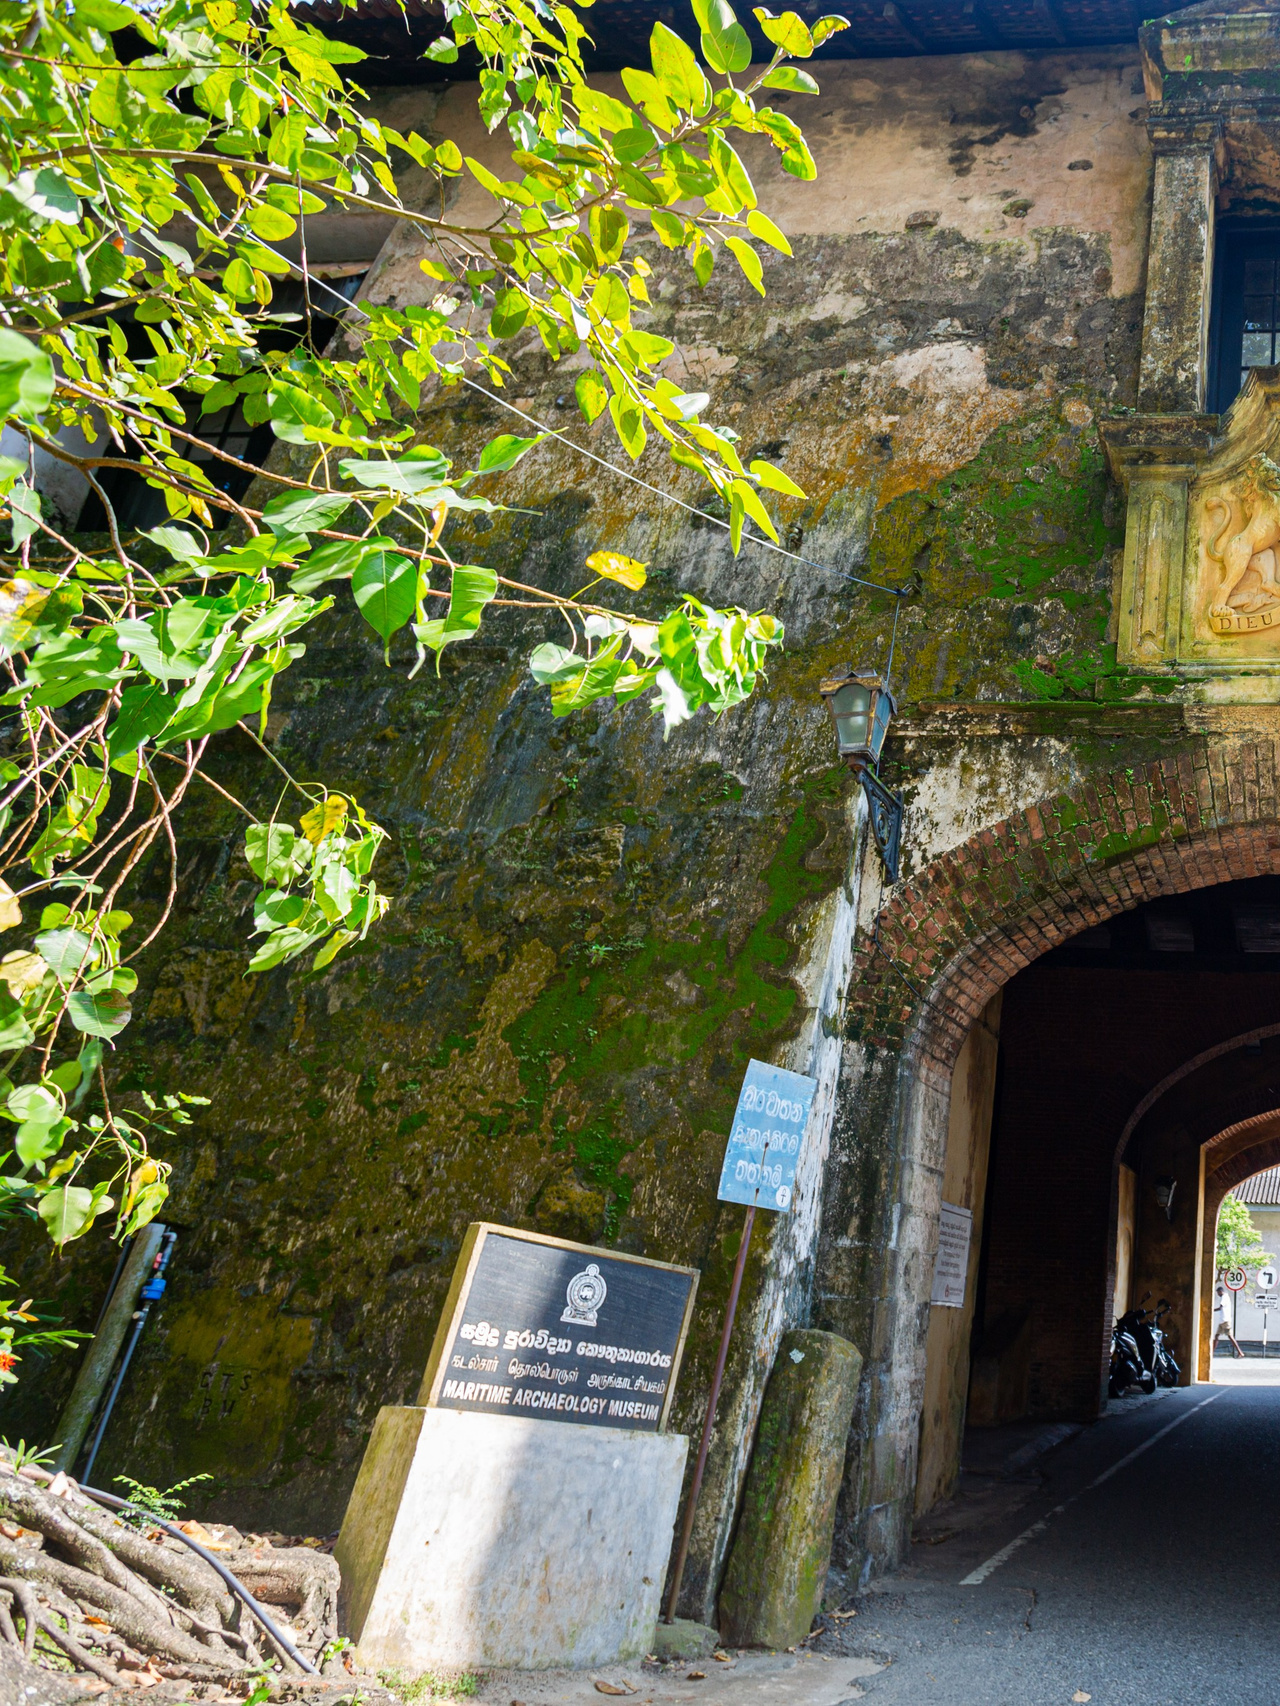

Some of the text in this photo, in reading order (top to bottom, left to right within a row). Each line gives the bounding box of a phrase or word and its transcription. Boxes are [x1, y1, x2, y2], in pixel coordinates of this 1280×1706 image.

[1219, 612, 1273, 630] DIEU
[1229, 1272, 1243, 1282] 30
[451, 1353, 500, 1373] கடல்சார்
[508, 1358, 579, 1385] தொல்பொருள்
[443, 1379, 660, 1421] MARITIME ARCHAEOLOGY MUSEUM
